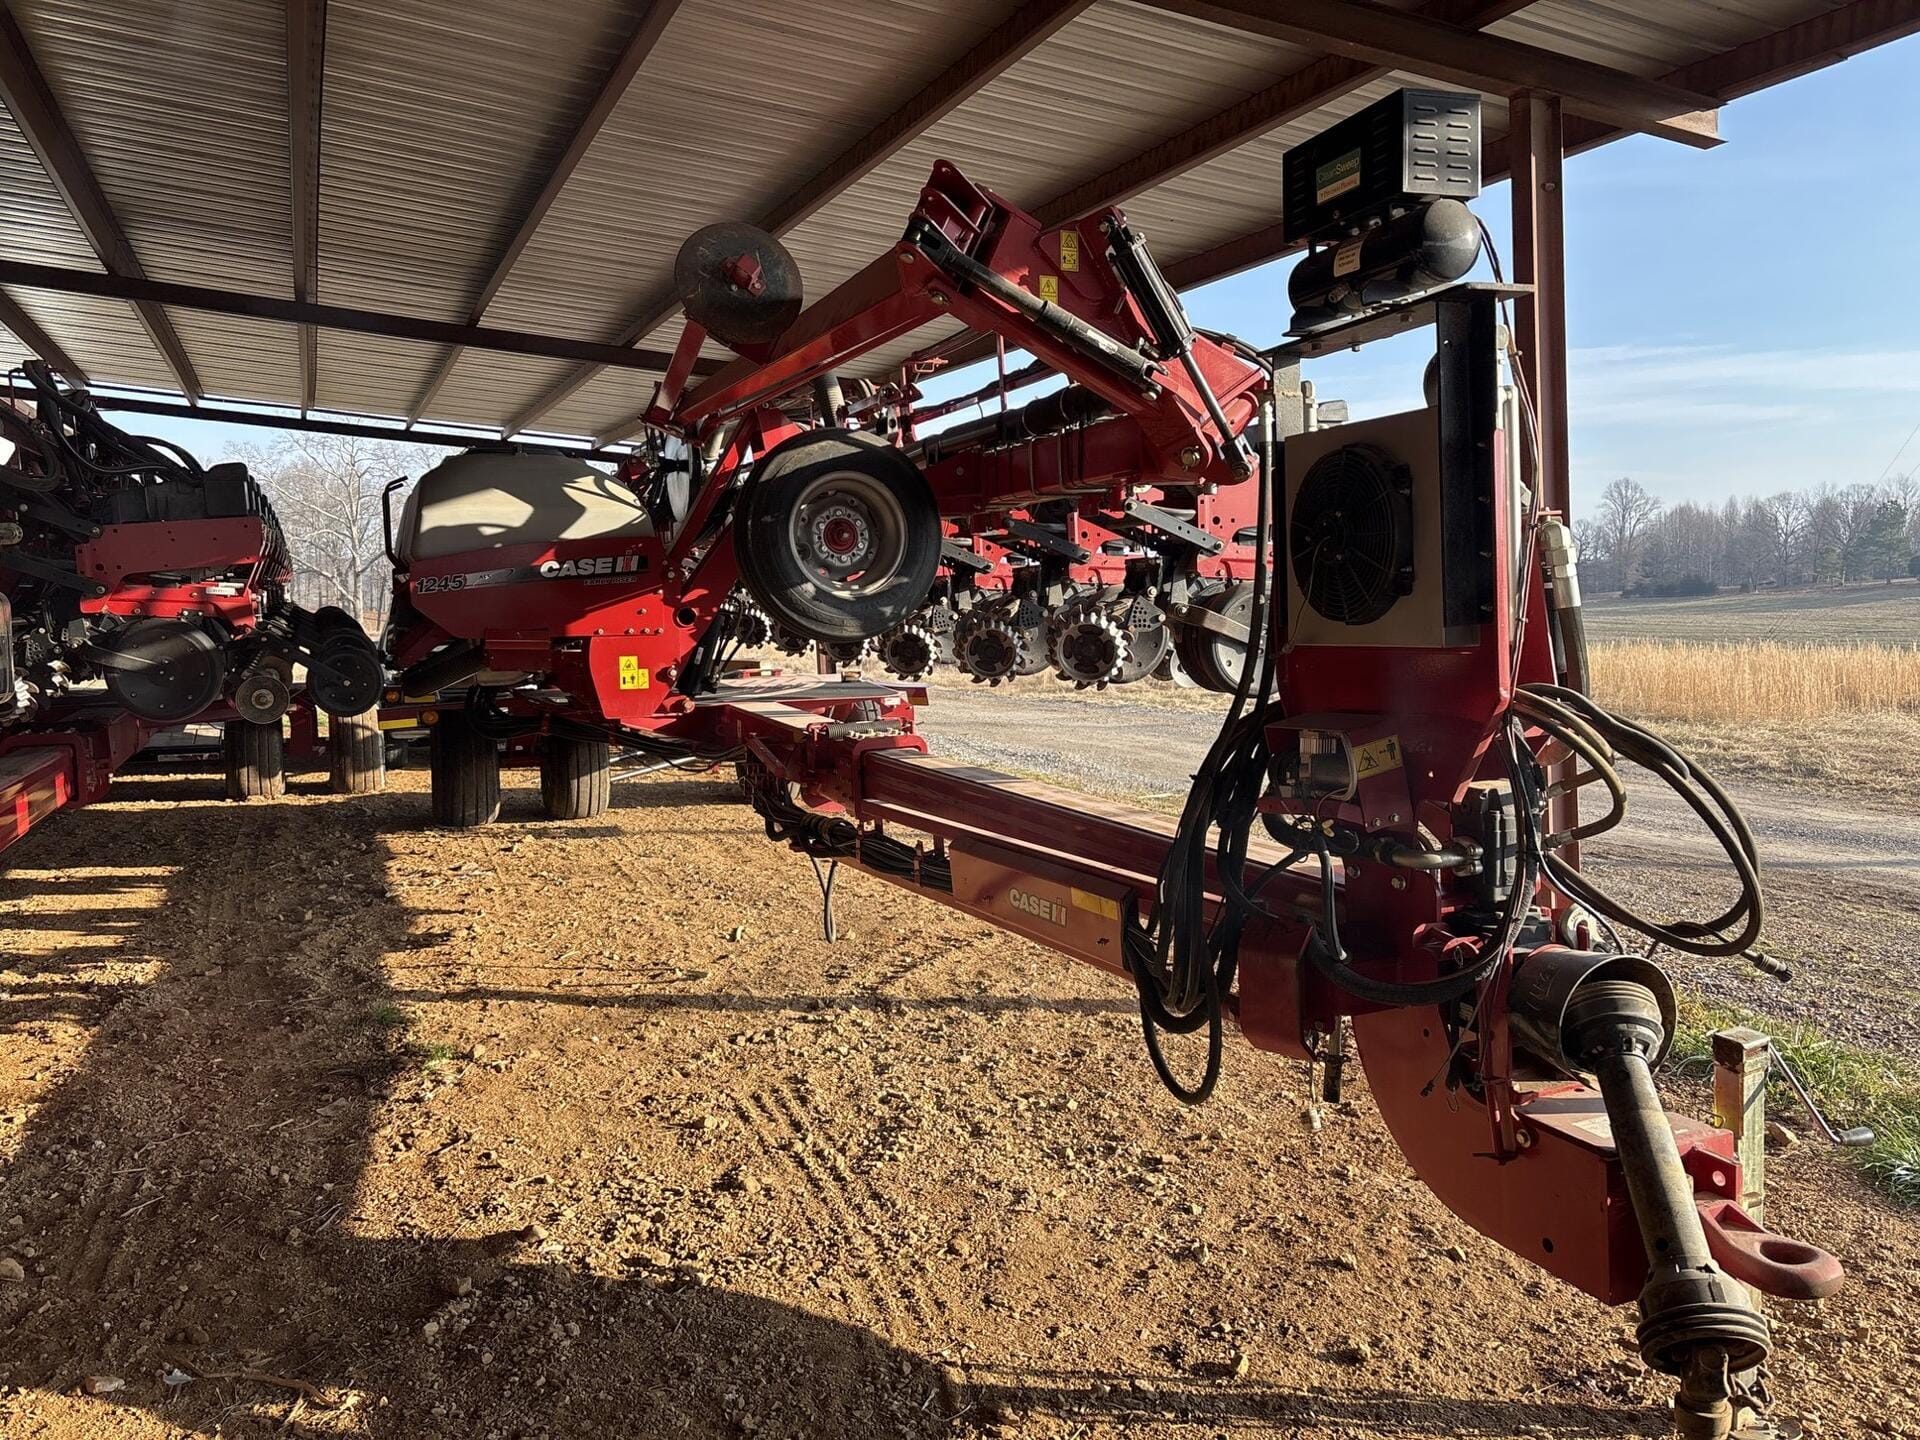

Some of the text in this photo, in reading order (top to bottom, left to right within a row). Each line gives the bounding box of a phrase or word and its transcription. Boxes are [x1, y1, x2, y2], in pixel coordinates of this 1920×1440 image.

[540, 556, 613, 578] CASE
[416, 573, 466, 594] 1245
[1008, 887, 1051, 920] CASE
